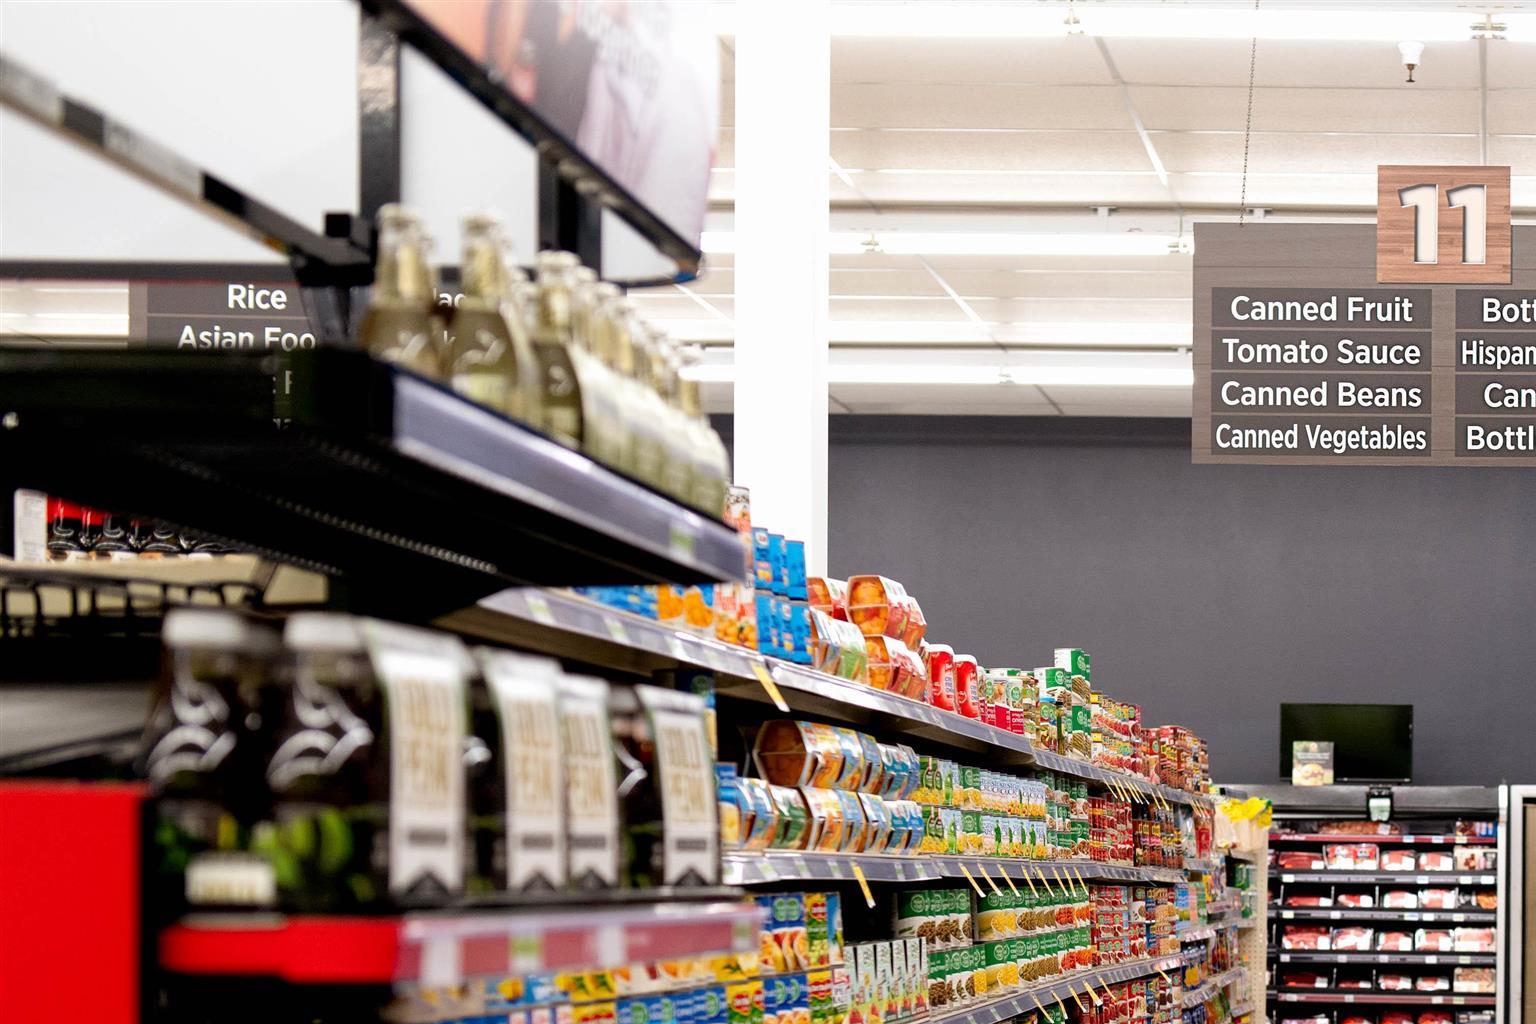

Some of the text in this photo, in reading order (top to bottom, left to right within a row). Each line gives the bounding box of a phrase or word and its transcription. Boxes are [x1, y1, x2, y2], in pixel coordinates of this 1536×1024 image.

[1397, 183, 1487, 265] 11
[228, 283, 288, 311] Rice
[1230, 295, 1413, 322] Canned Fruit
[178, 324, 255, 348] Asian
[1222, 338, 1421, 365] Tomato Sauce
[1221, 380, 1422, 407] Canned Beans
[1215, 423, 1427, 454] Canned Vegetables
